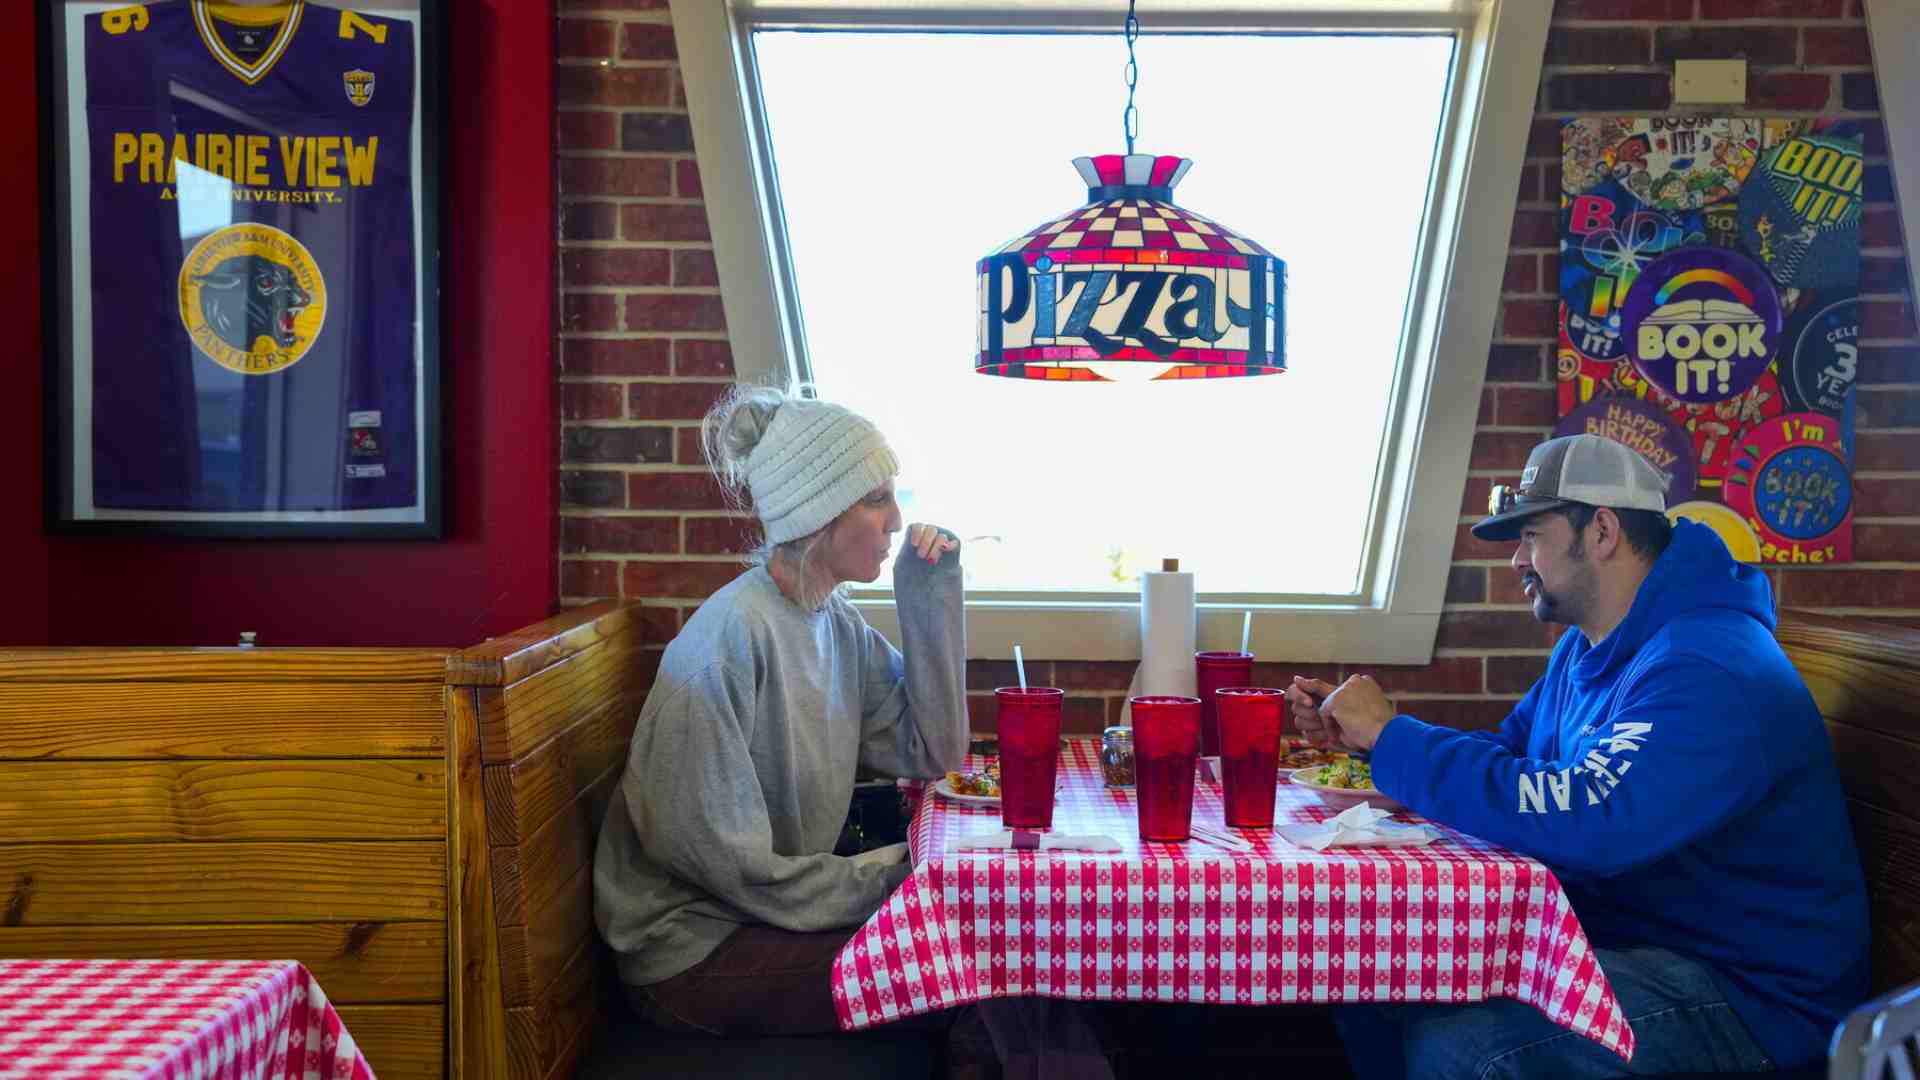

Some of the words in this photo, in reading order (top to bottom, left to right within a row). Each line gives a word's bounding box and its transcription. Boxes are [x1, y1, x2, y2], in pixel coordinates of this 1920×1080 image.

[113, 132, 270, 187] PRAIRIE
[279, 136, 379, 187] VIEW
[1774, 138, 1863, 192] BOO
[229, 189, 336, 203] NIVERSITY
[1792, 184, 1850, 226] IT!
[987, 252, 1232, 358] Pizza
[192, 321, 291, 369] PANTHERS
[1581, 334, 1613, 357] IT!
[1637, 323, 1767, 360] BOOK
[1675, 359, 1730, 395] IT!
[1607, 403, 1666, 438] HAPPY
[1782, 417, 1825, 442] I'm
[1586, 415, 1679, 466] BIRTHDAY
[1765, 468, 1840, 506] BOOK
